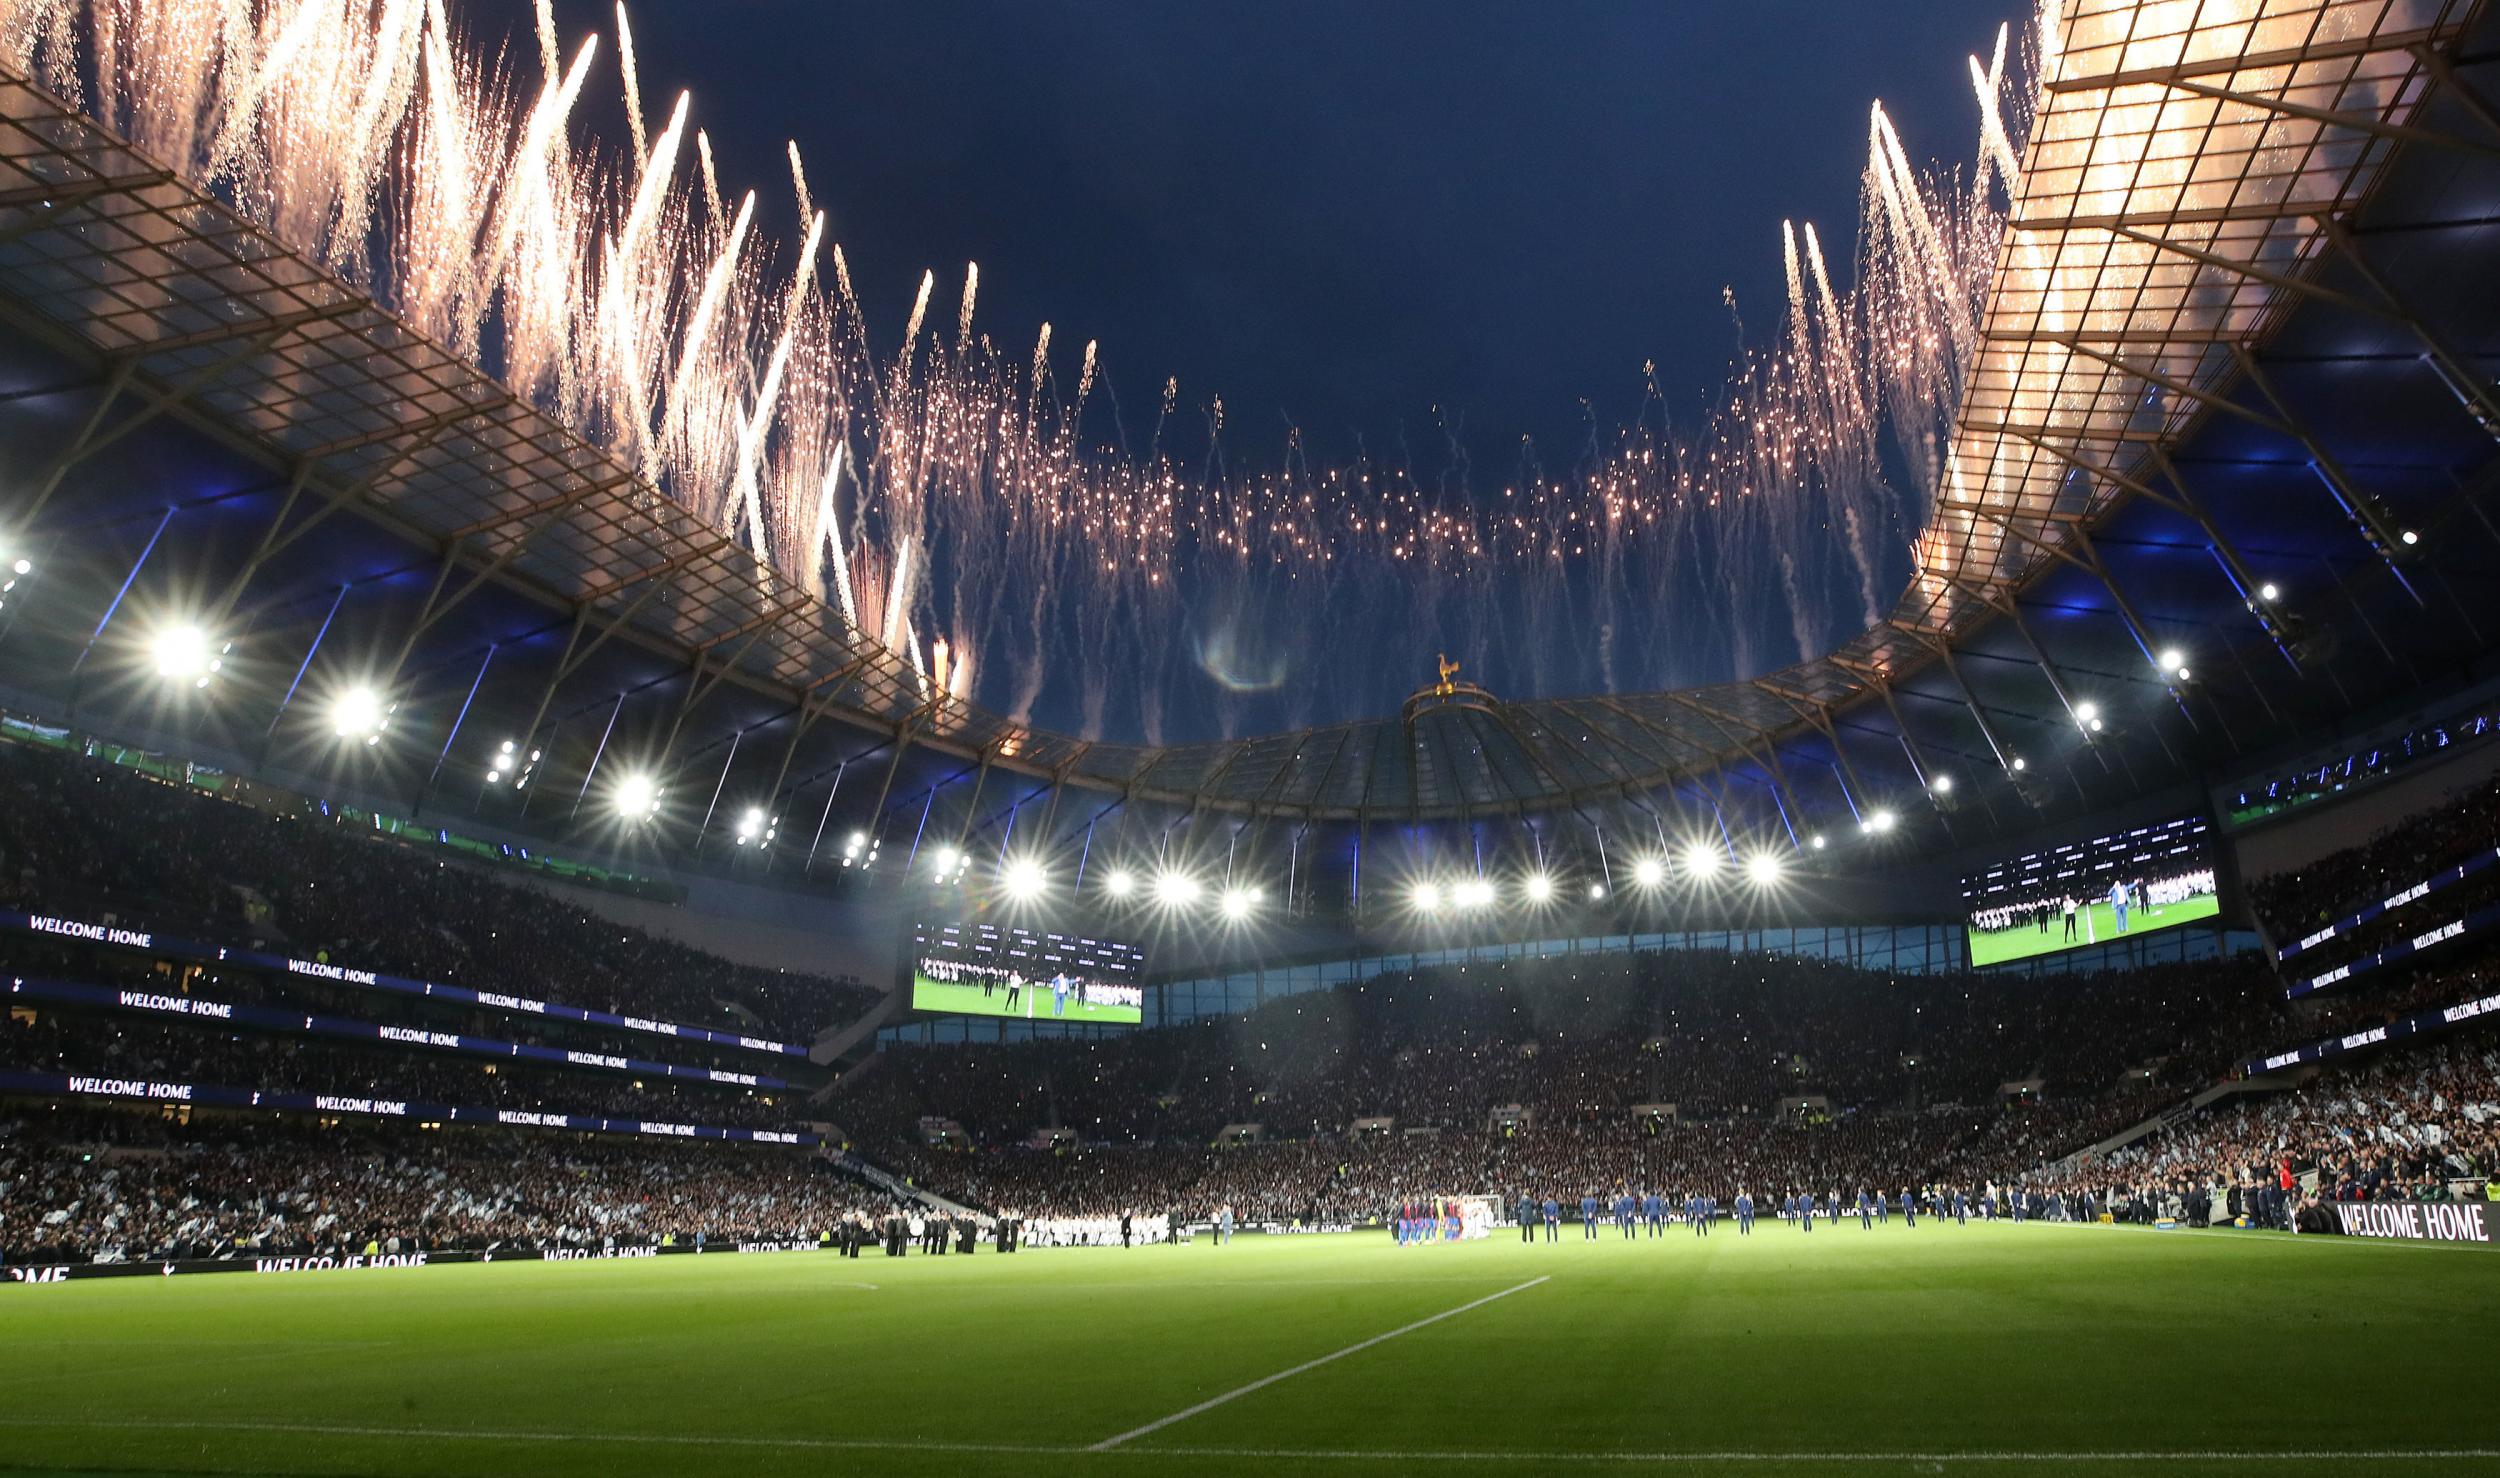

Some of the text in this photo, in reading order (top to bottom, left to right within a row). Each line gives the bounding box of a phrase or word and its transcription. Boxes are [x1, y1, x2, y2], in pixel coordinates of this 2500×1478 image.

[2411, 881, 2429, 899] HOME
[31, 915, 150, 947] WELCOME HOME
[2413, 920, 2465, 950] WELCOME HOME
[289, 959, 376, 985] WELCOME HOME
[121, 991, 231, 1017] WELCOME HOME
[478, 992, 545, 1013] WELCOME HOME
[2444, 995, 2500, 1022] WELCOME HOM
[380, 1026, 458, 1047] WELCOME HOME
[625, 1017, 677, 1035] WELCOME HOME
[2342, 1027, 2386, 1049] WELCOME HOME
[568, 1051, 627, 1068] WELCOME HOME
[70, 1077, 191, 1099] WELCOME HOME
[316, 1096, 405, 1114] WELCOME HOME
[499, 1111, 567, 1126] WELCOME HOME
[640, 1122, 695, 1136] WELCOME HOME
[2337, 1204, 2489, 1241] WELCOME HOME
[370, 1253, 428, 1269] HOME
[618, 1245, 658, 1259] HOME
